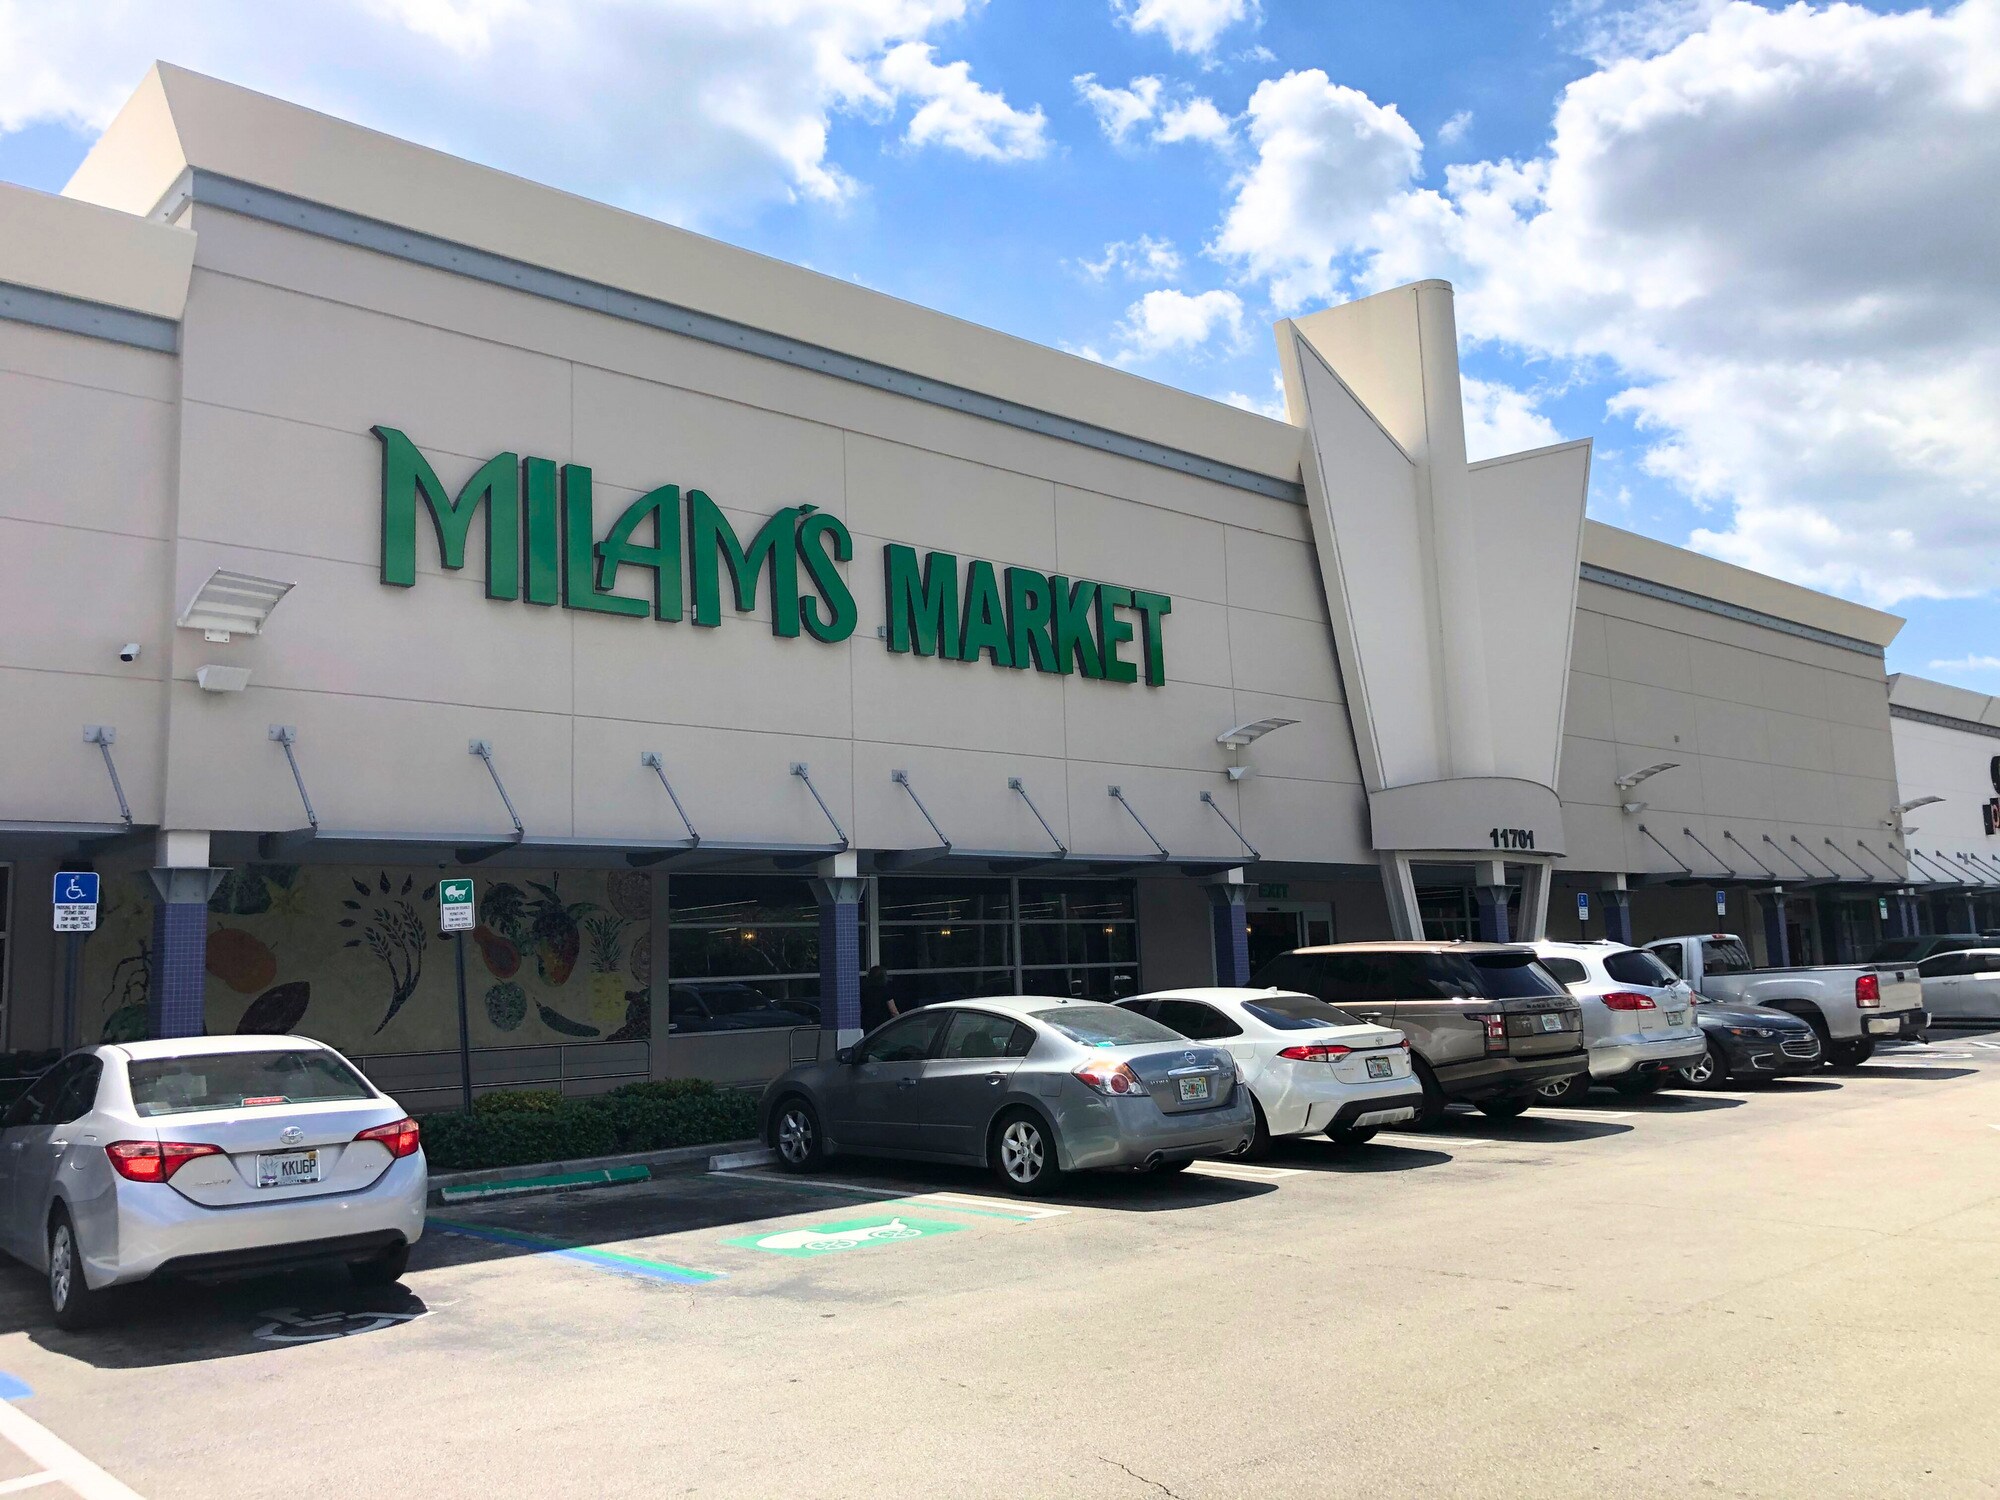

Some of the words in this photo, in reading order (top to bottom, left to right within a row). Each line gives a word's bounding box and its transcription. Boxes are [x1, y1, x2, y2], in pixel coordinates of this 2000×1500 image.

[370, 425, 857, 643] MILAM'S
[883, 543, 1171, 688] MARKET
[1490, 828, 1535, 849] 11701
